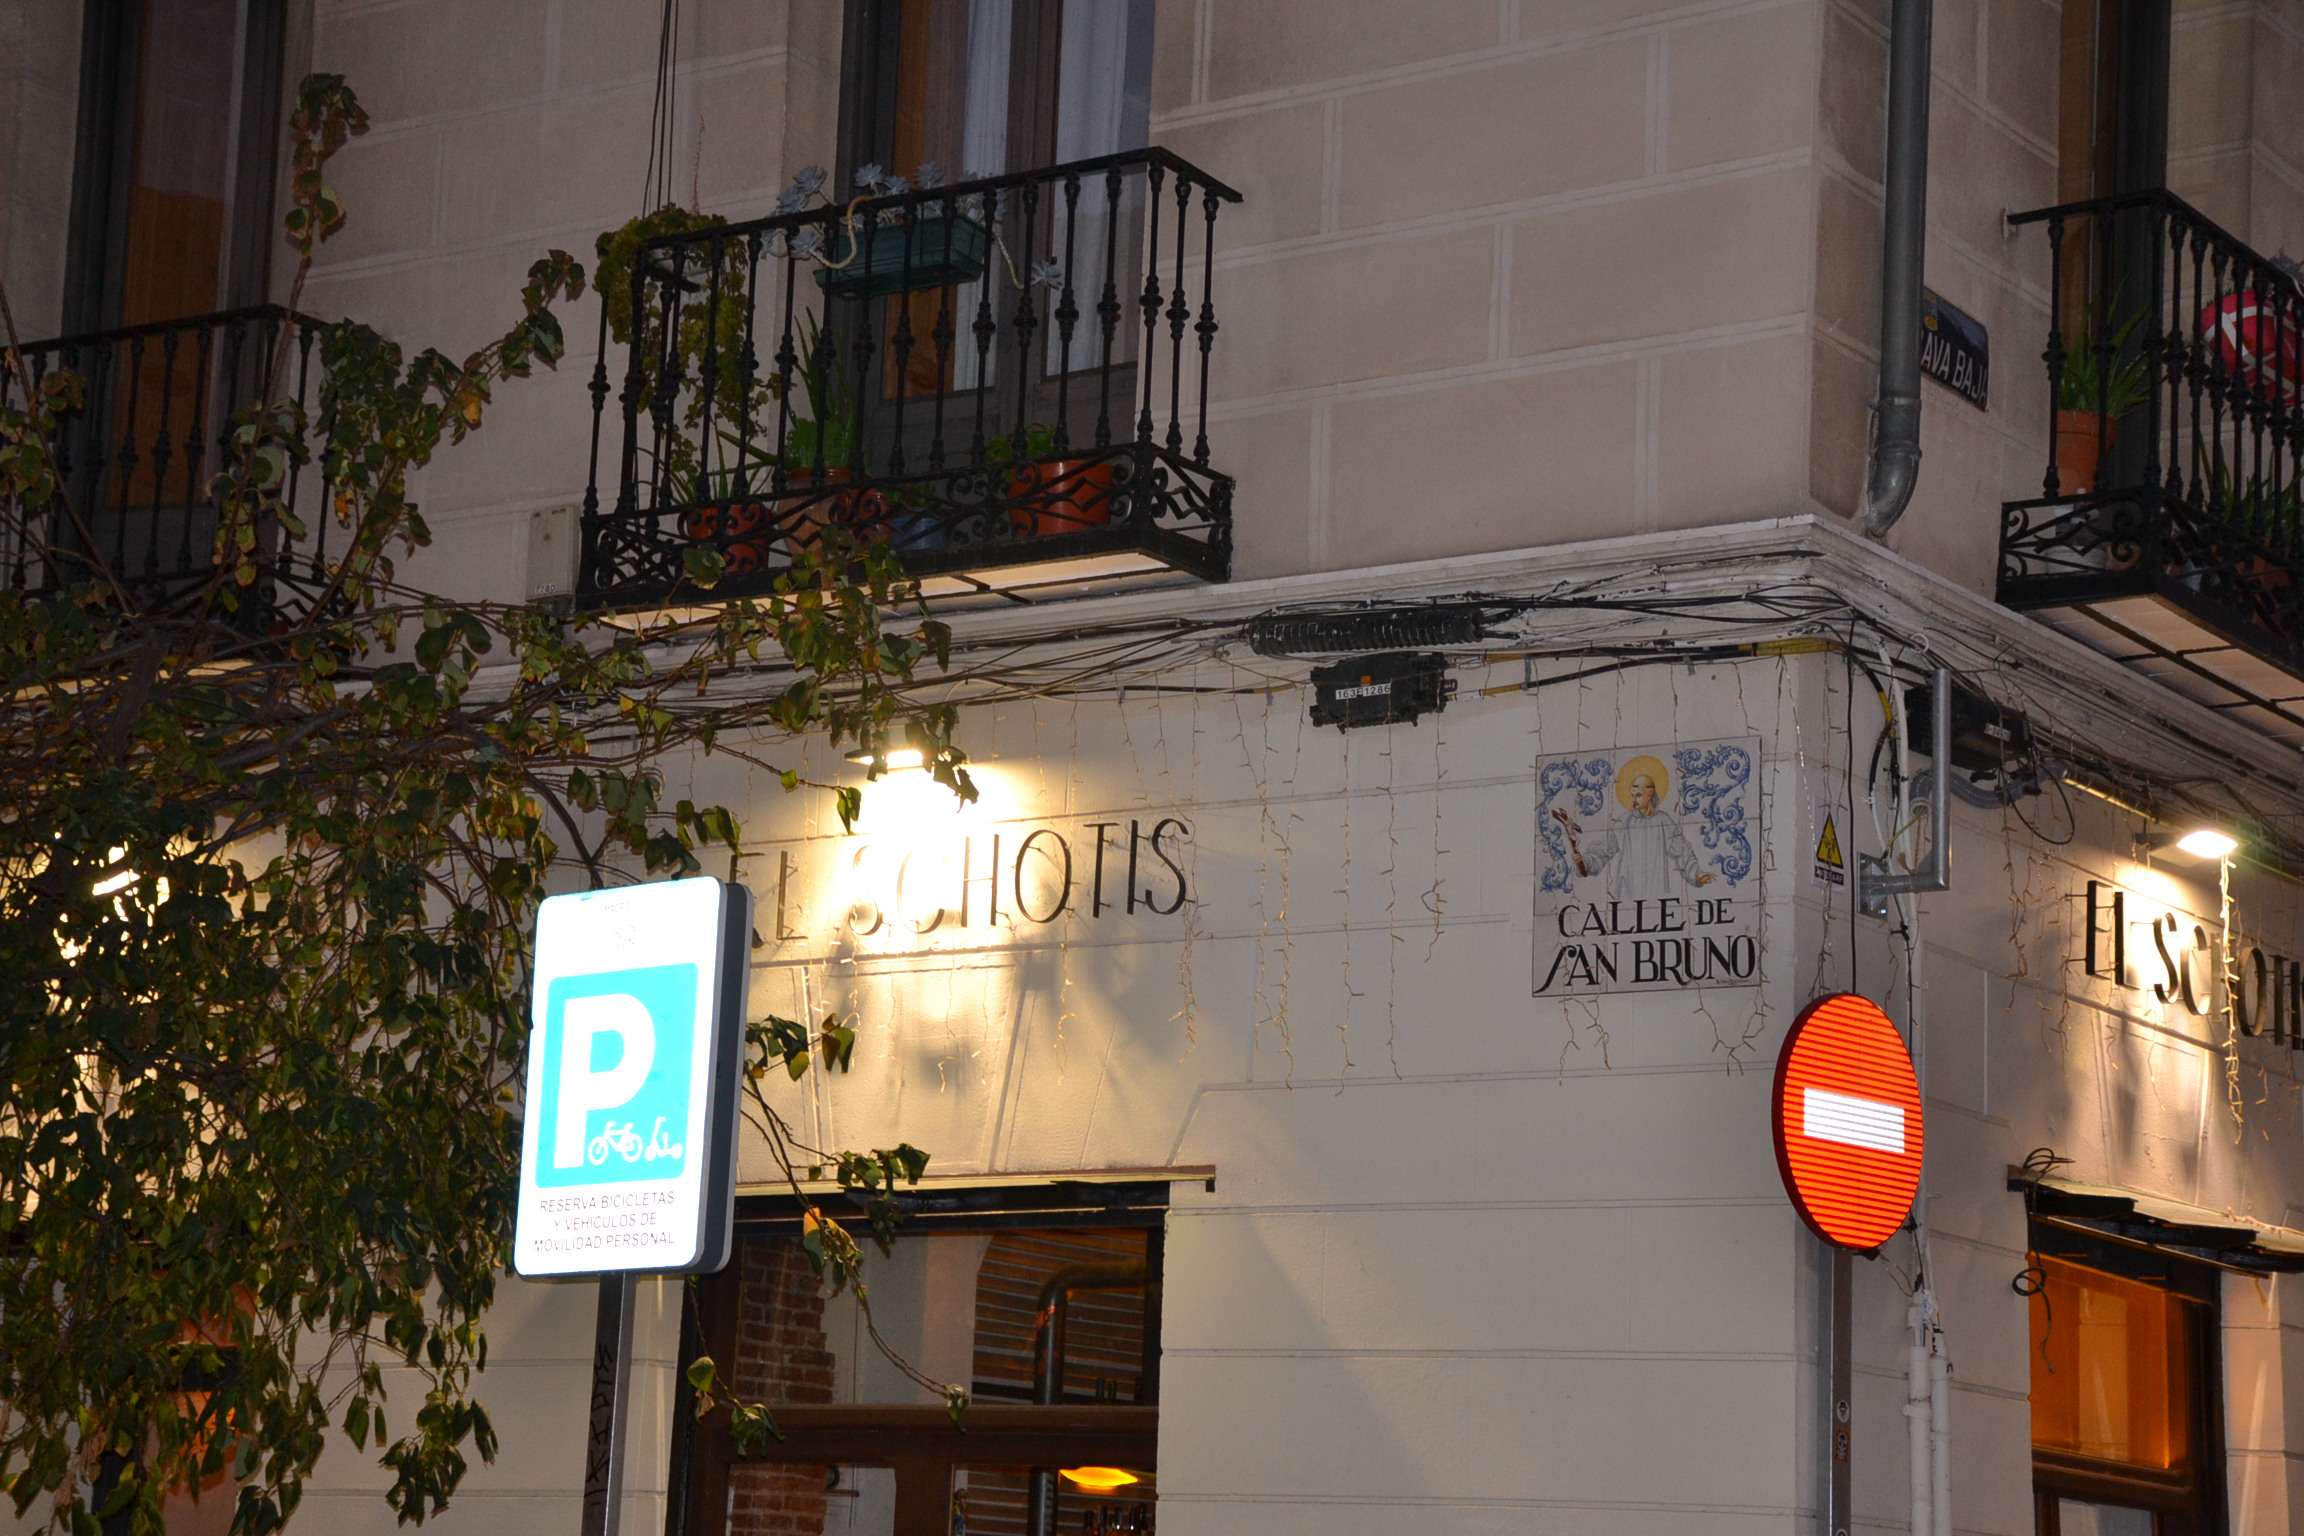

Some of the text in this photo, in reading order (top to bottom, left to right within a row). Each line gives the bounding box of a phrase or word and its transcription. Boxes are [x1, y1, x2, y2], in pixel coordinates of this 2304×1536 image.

[1921, 329, 1951, 381] AVA
[849, 818, 1189, 936] SCHOTIS
[1558, 897, 1736, 938] CALLE DE
[1533, 934, 1756, 994] SAN BRUNO
[2153, 912, 2304, 1051] SCHOTI
[553, 992, 656, 1170] P
[540, 1191, 675, 1212] RESERVA BICICLETAS
[554, 1212, 657, 1231] Y VEHICULOS DE
[534, 1231, 675, 1252] MOVILIDAD PERSONAL
